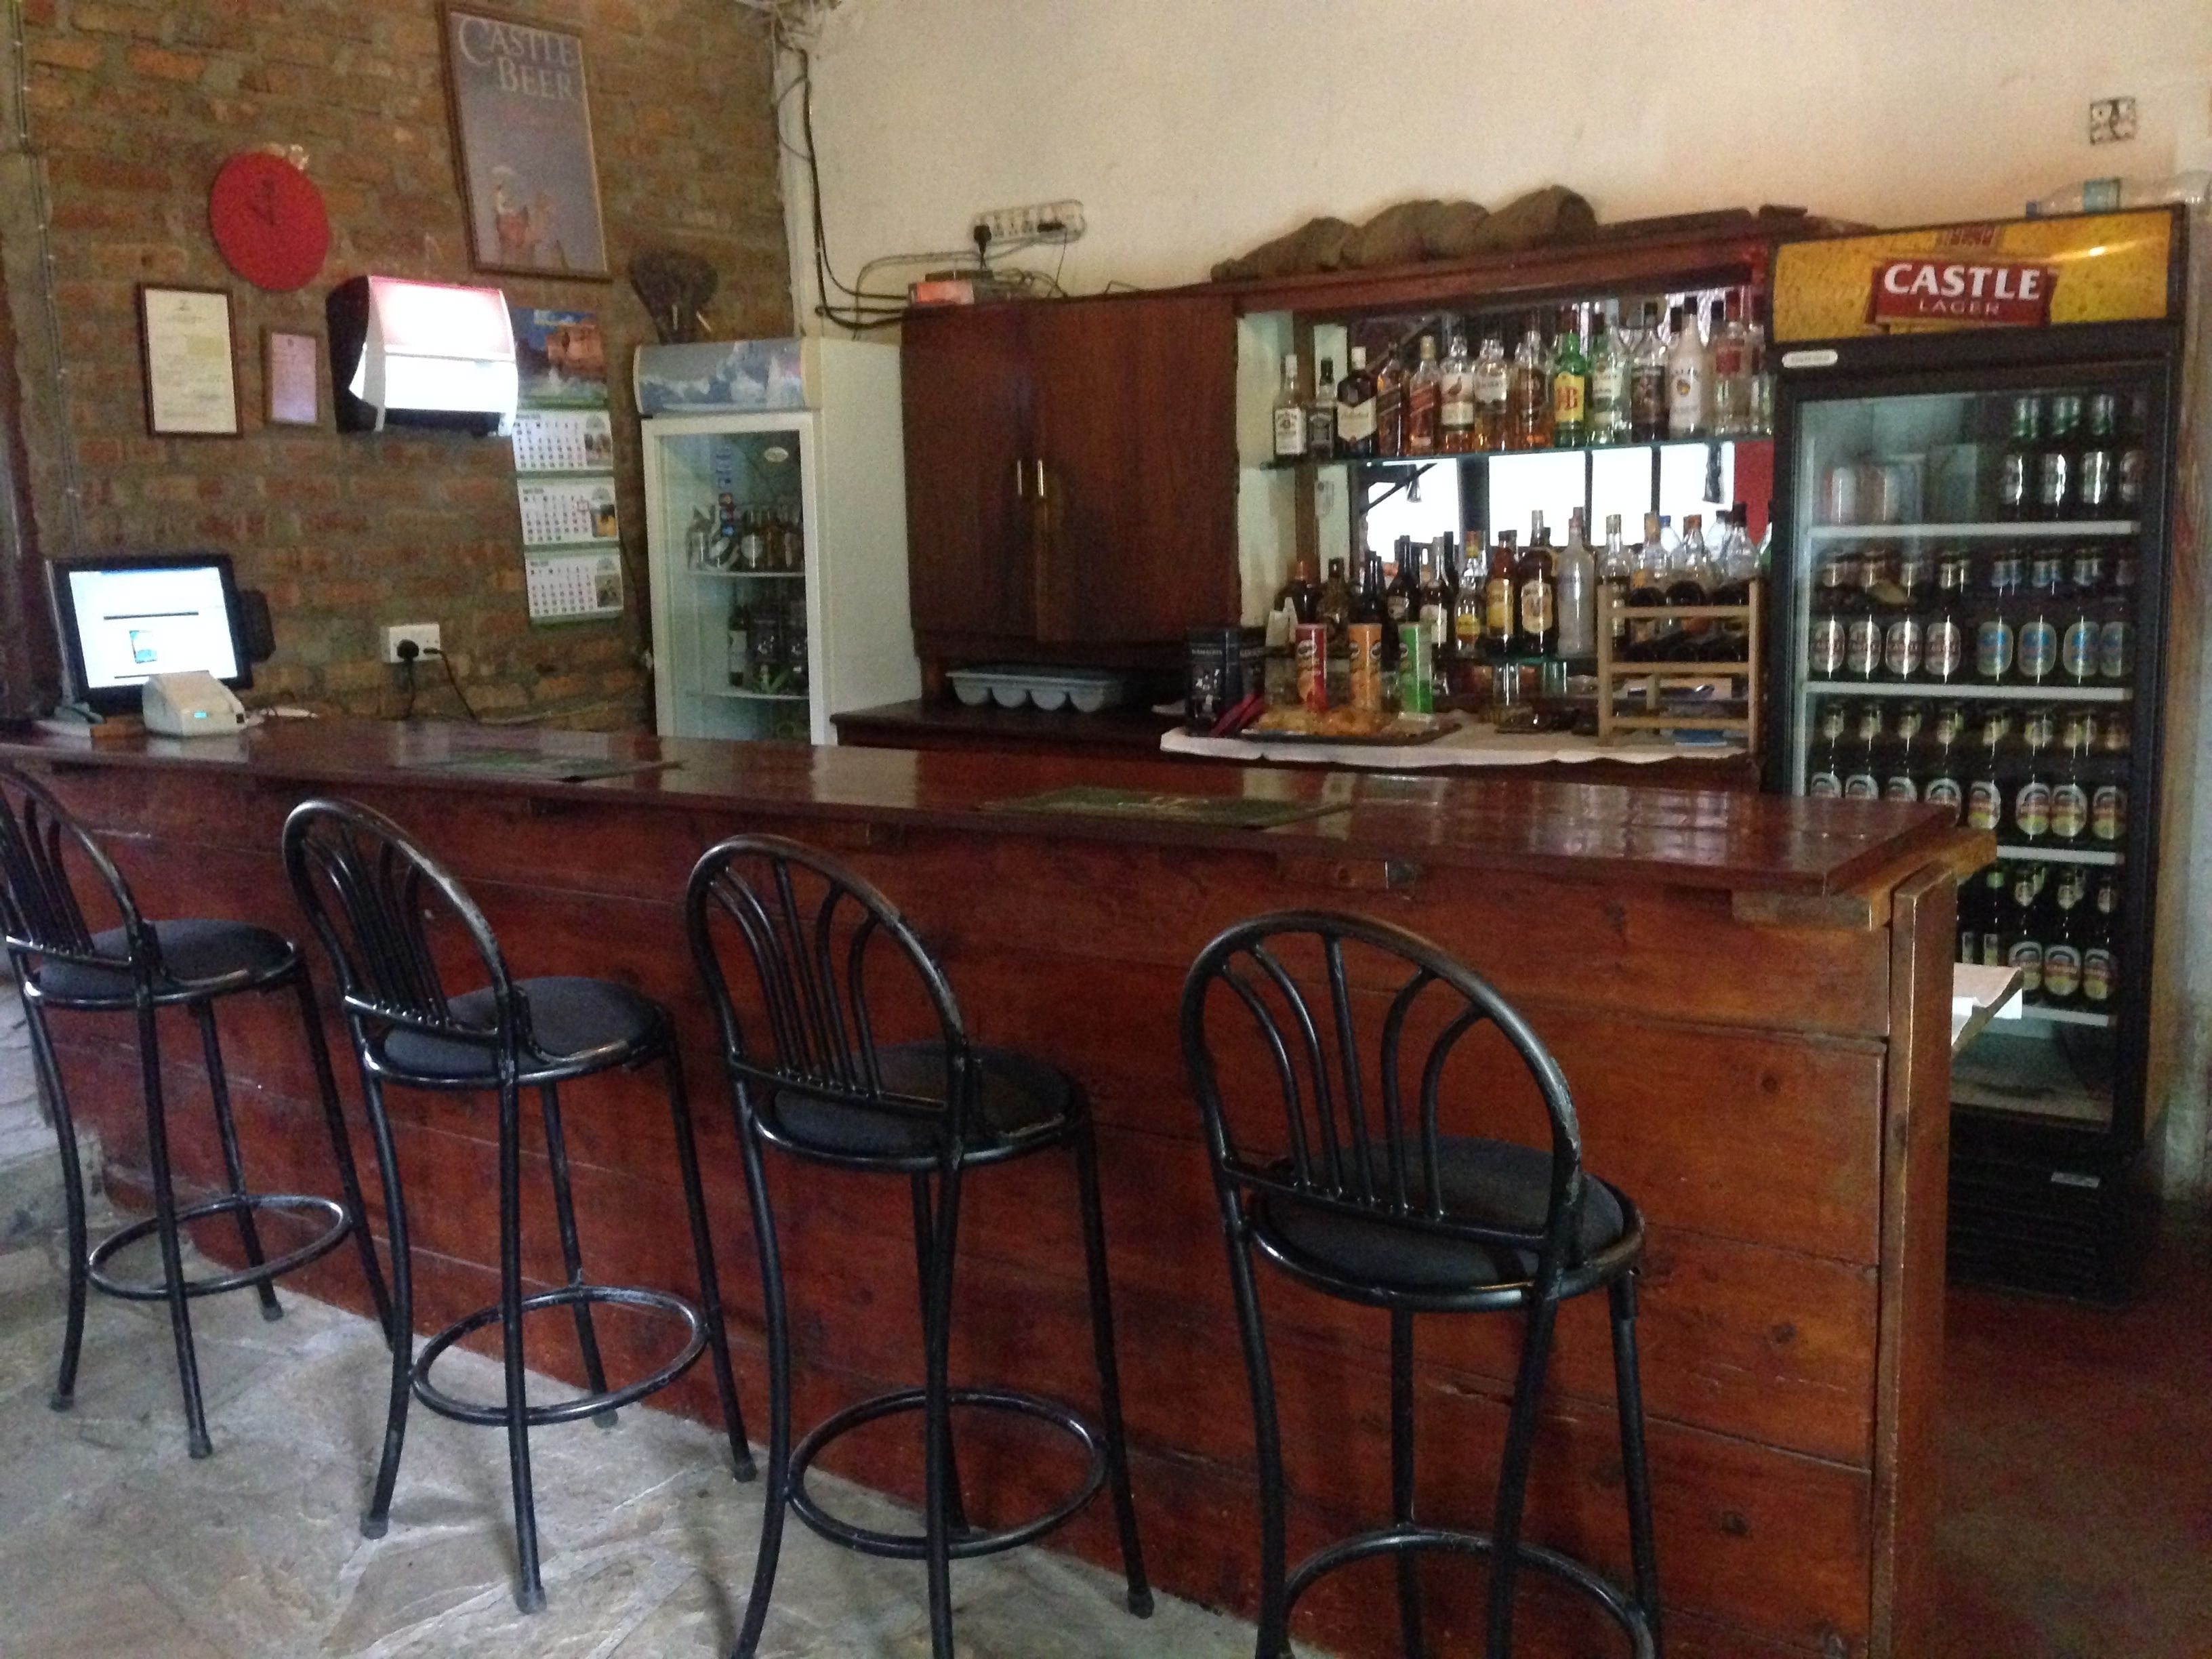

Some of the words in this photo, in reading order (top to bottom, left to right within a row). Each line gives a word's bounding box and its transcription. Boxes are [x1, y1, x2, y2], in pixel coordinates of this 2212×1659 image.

[458, 18, 575, 67] CASTLE
[498, 56, 573, 99] BEER
[1883, 262, 2042, 301] CASTLE
[1919, 298, 2001, 316] LAGER
